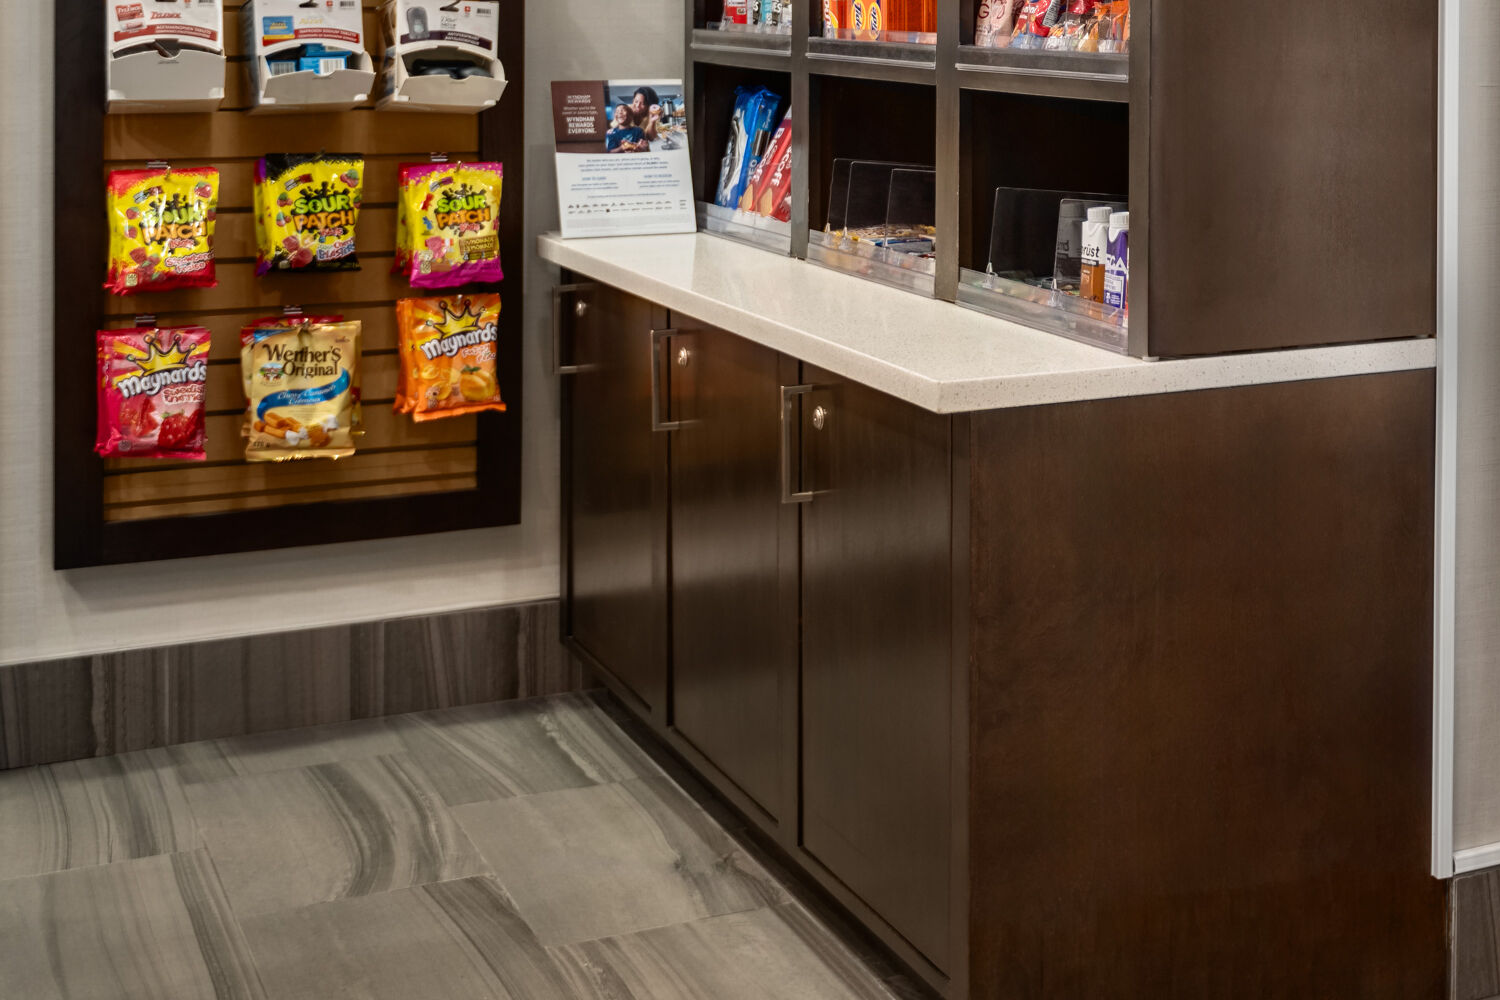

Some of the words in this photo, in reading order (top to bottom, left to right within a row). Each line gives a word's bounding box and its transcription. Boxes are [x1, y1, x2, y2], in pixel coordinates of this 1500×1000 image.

[853, 2, 865, 33] Tide
[870, 6, 881, 38] Tide
[294, 194, 350, 214] SOUR
[436, 195, 488, 213] SOUR
[143, 205, 204, 227] SOUR
[292, 210, 356, 232] PATCH
[435, 206, 492, 231] PATCH
[141, 221, 207, 246] PATCH
[263, 343, 342, 363] Werther's
[282, 360, 338, 378] Original
